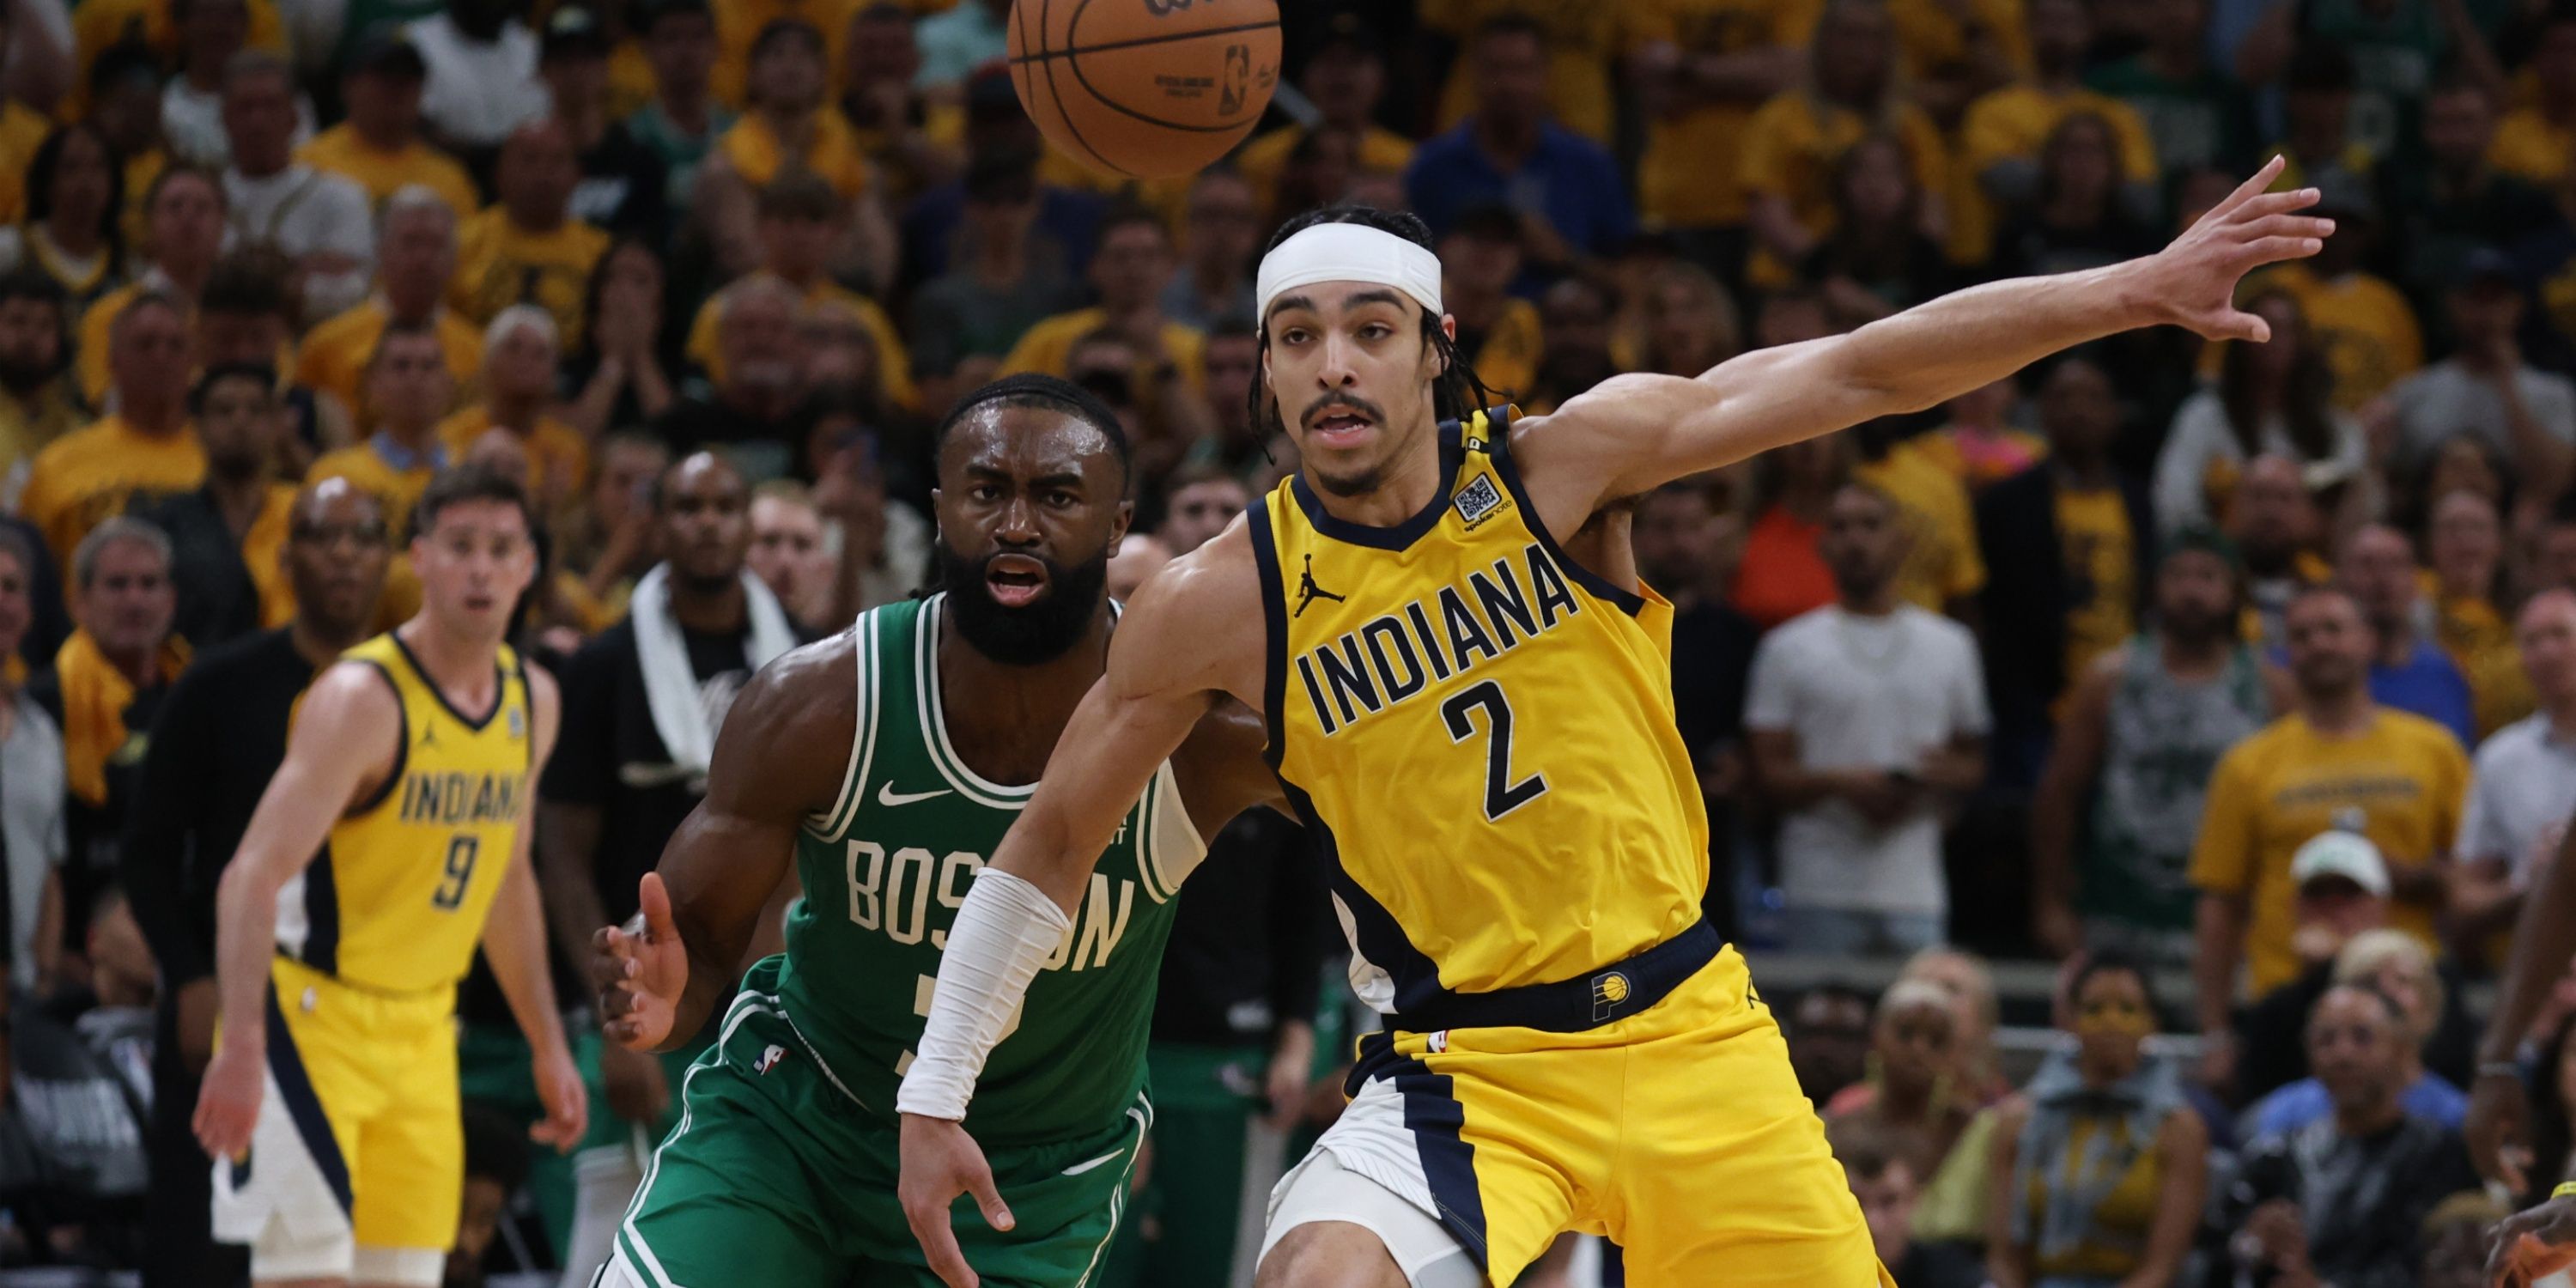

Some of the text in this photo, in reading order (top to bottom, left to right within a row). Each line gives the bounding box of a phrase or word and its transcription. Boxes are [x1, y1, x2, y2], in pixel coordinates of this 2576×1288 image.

[1464, 500, 1512, 532] spokenote
[1294, 540, 1581, 738] INDIANA
[1439, 677, 1550, 823] 2
[432, 835, 479, 911] 9
[846, 838, 1135, 972] BOSN
